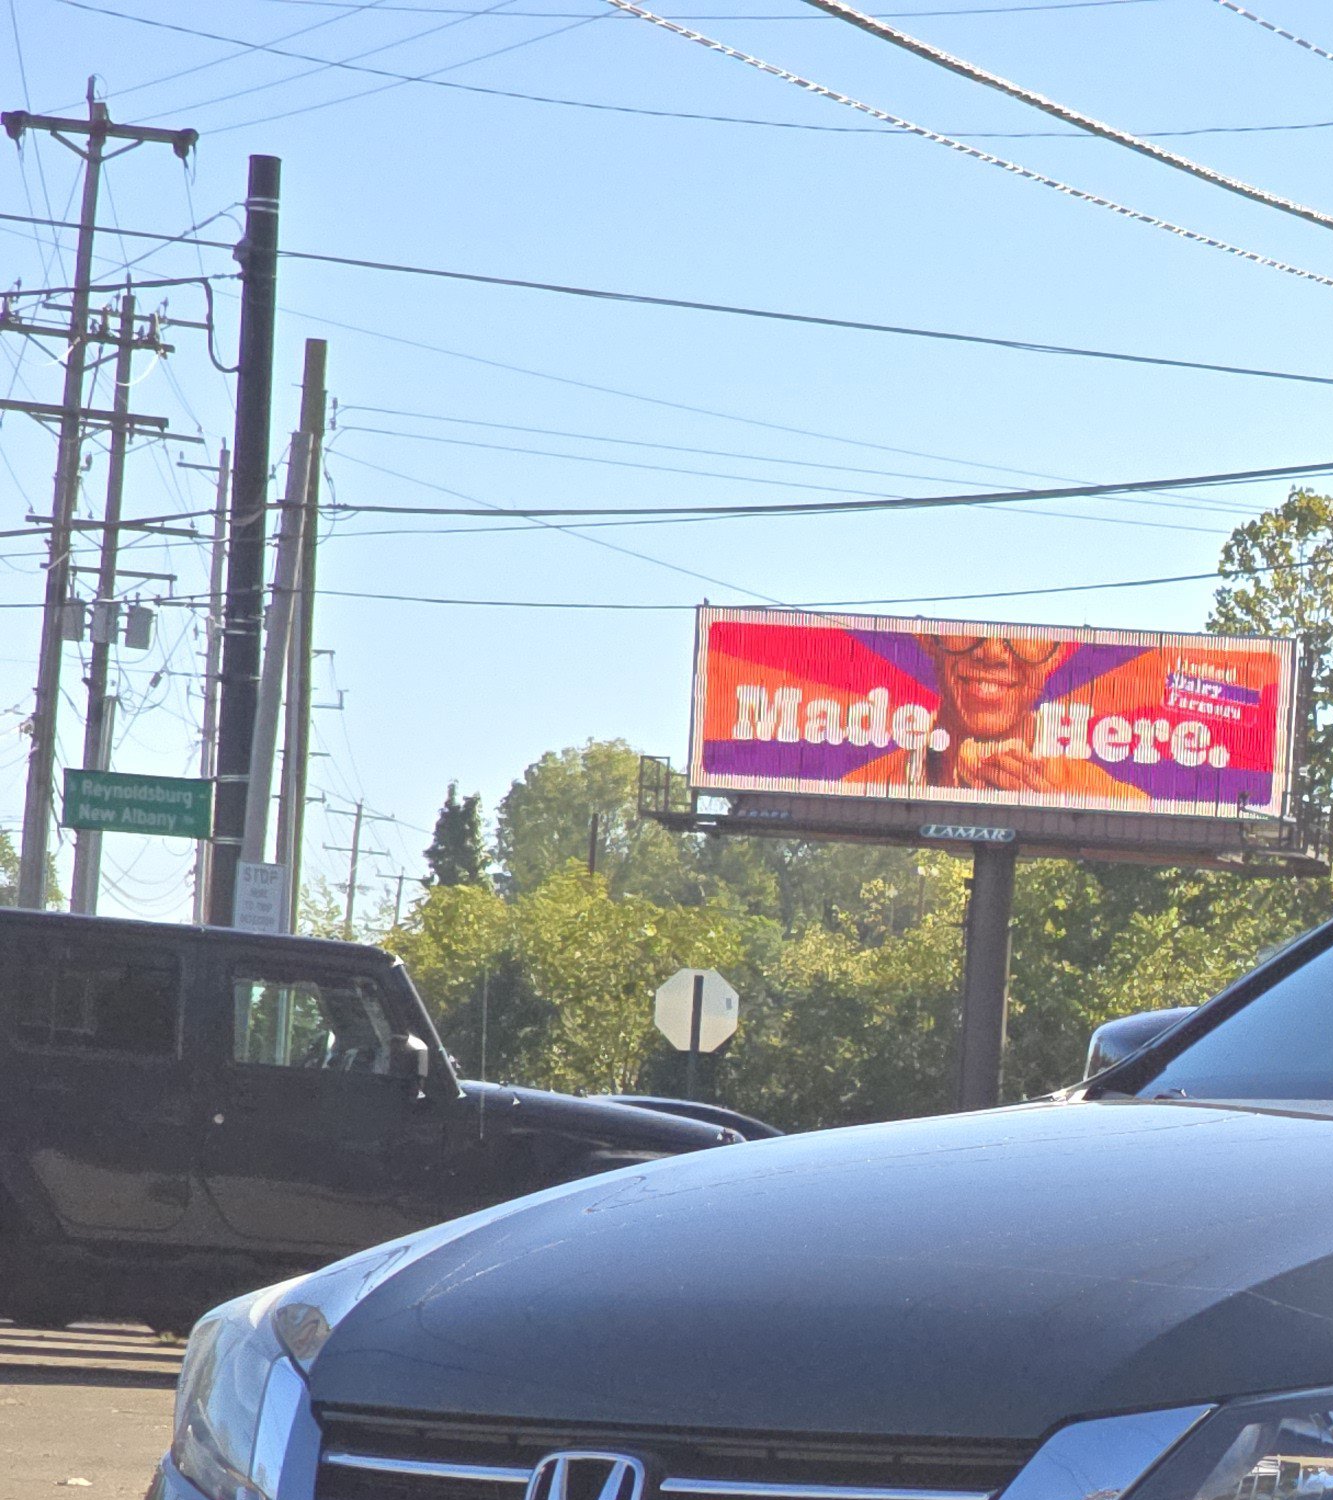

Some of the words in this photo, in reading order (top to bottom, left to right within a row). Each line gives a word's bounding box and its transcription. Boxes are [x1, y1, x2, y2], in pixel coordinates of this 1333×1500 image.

[735, 686, 950, 752] Made.
[1033, 702, 1230, 768] Here.
[83, 780, 193, 808] Reynoldsburg
[80, 804, 117, 823] New
[122, 807, 178, 830] Albany
[927, 824, 1008, 841] LAMAR
